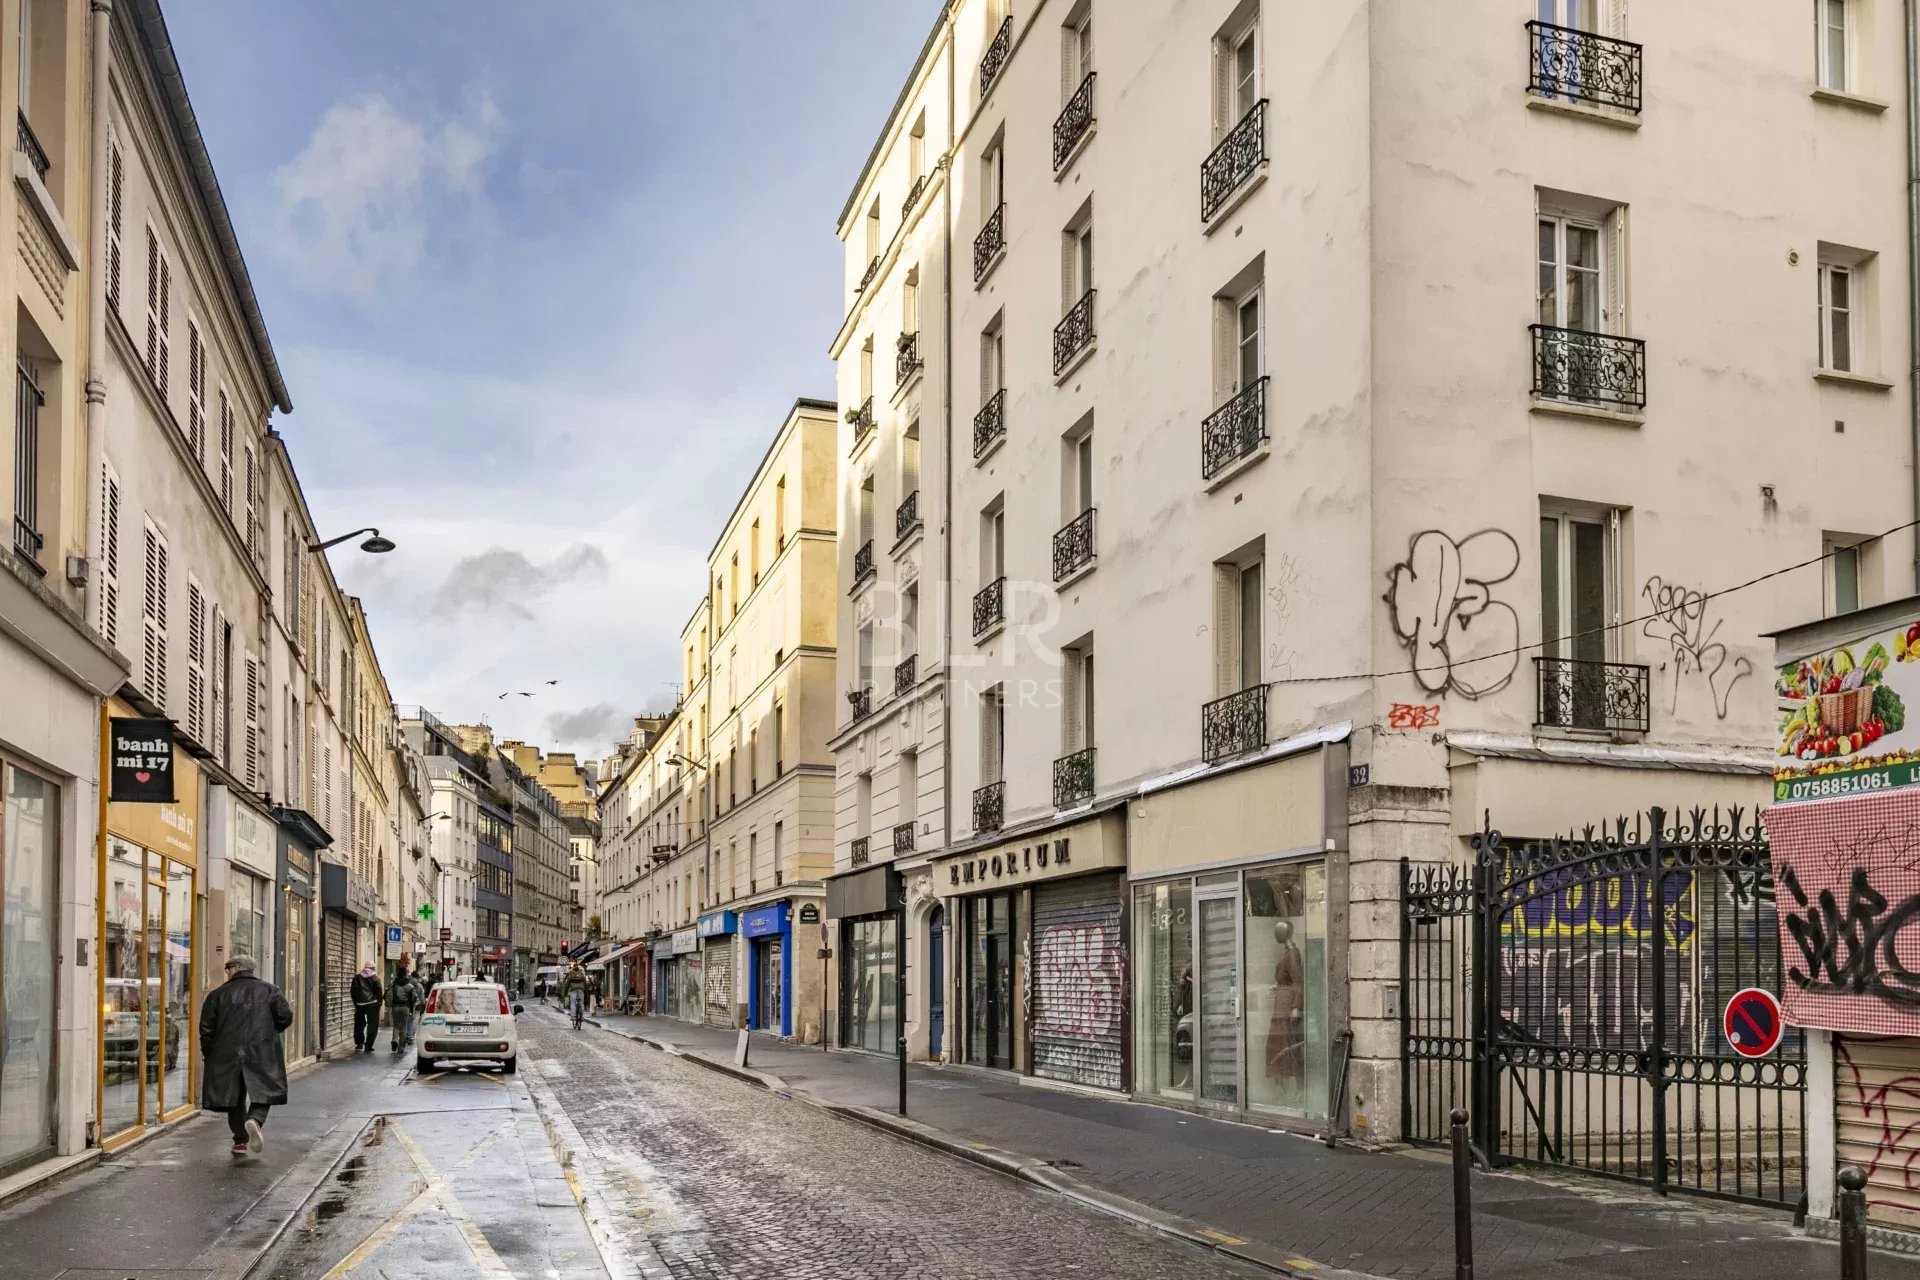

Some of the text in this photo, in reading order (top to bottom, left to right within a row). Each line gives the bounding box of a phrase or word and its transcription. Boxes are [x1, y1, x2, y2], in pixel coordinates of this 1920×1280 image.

[117, 737, 169, 753] banh
[116, 754, 170, 771] mi 17
[1353, 766, 1367, 785] 32
[1792, 771, 1892, 798] 0758851061
[161, 803, 177, 827] banh
[177, 813, 187, 833] mi
[949, 837, 1071, 886] EMPORIUM
